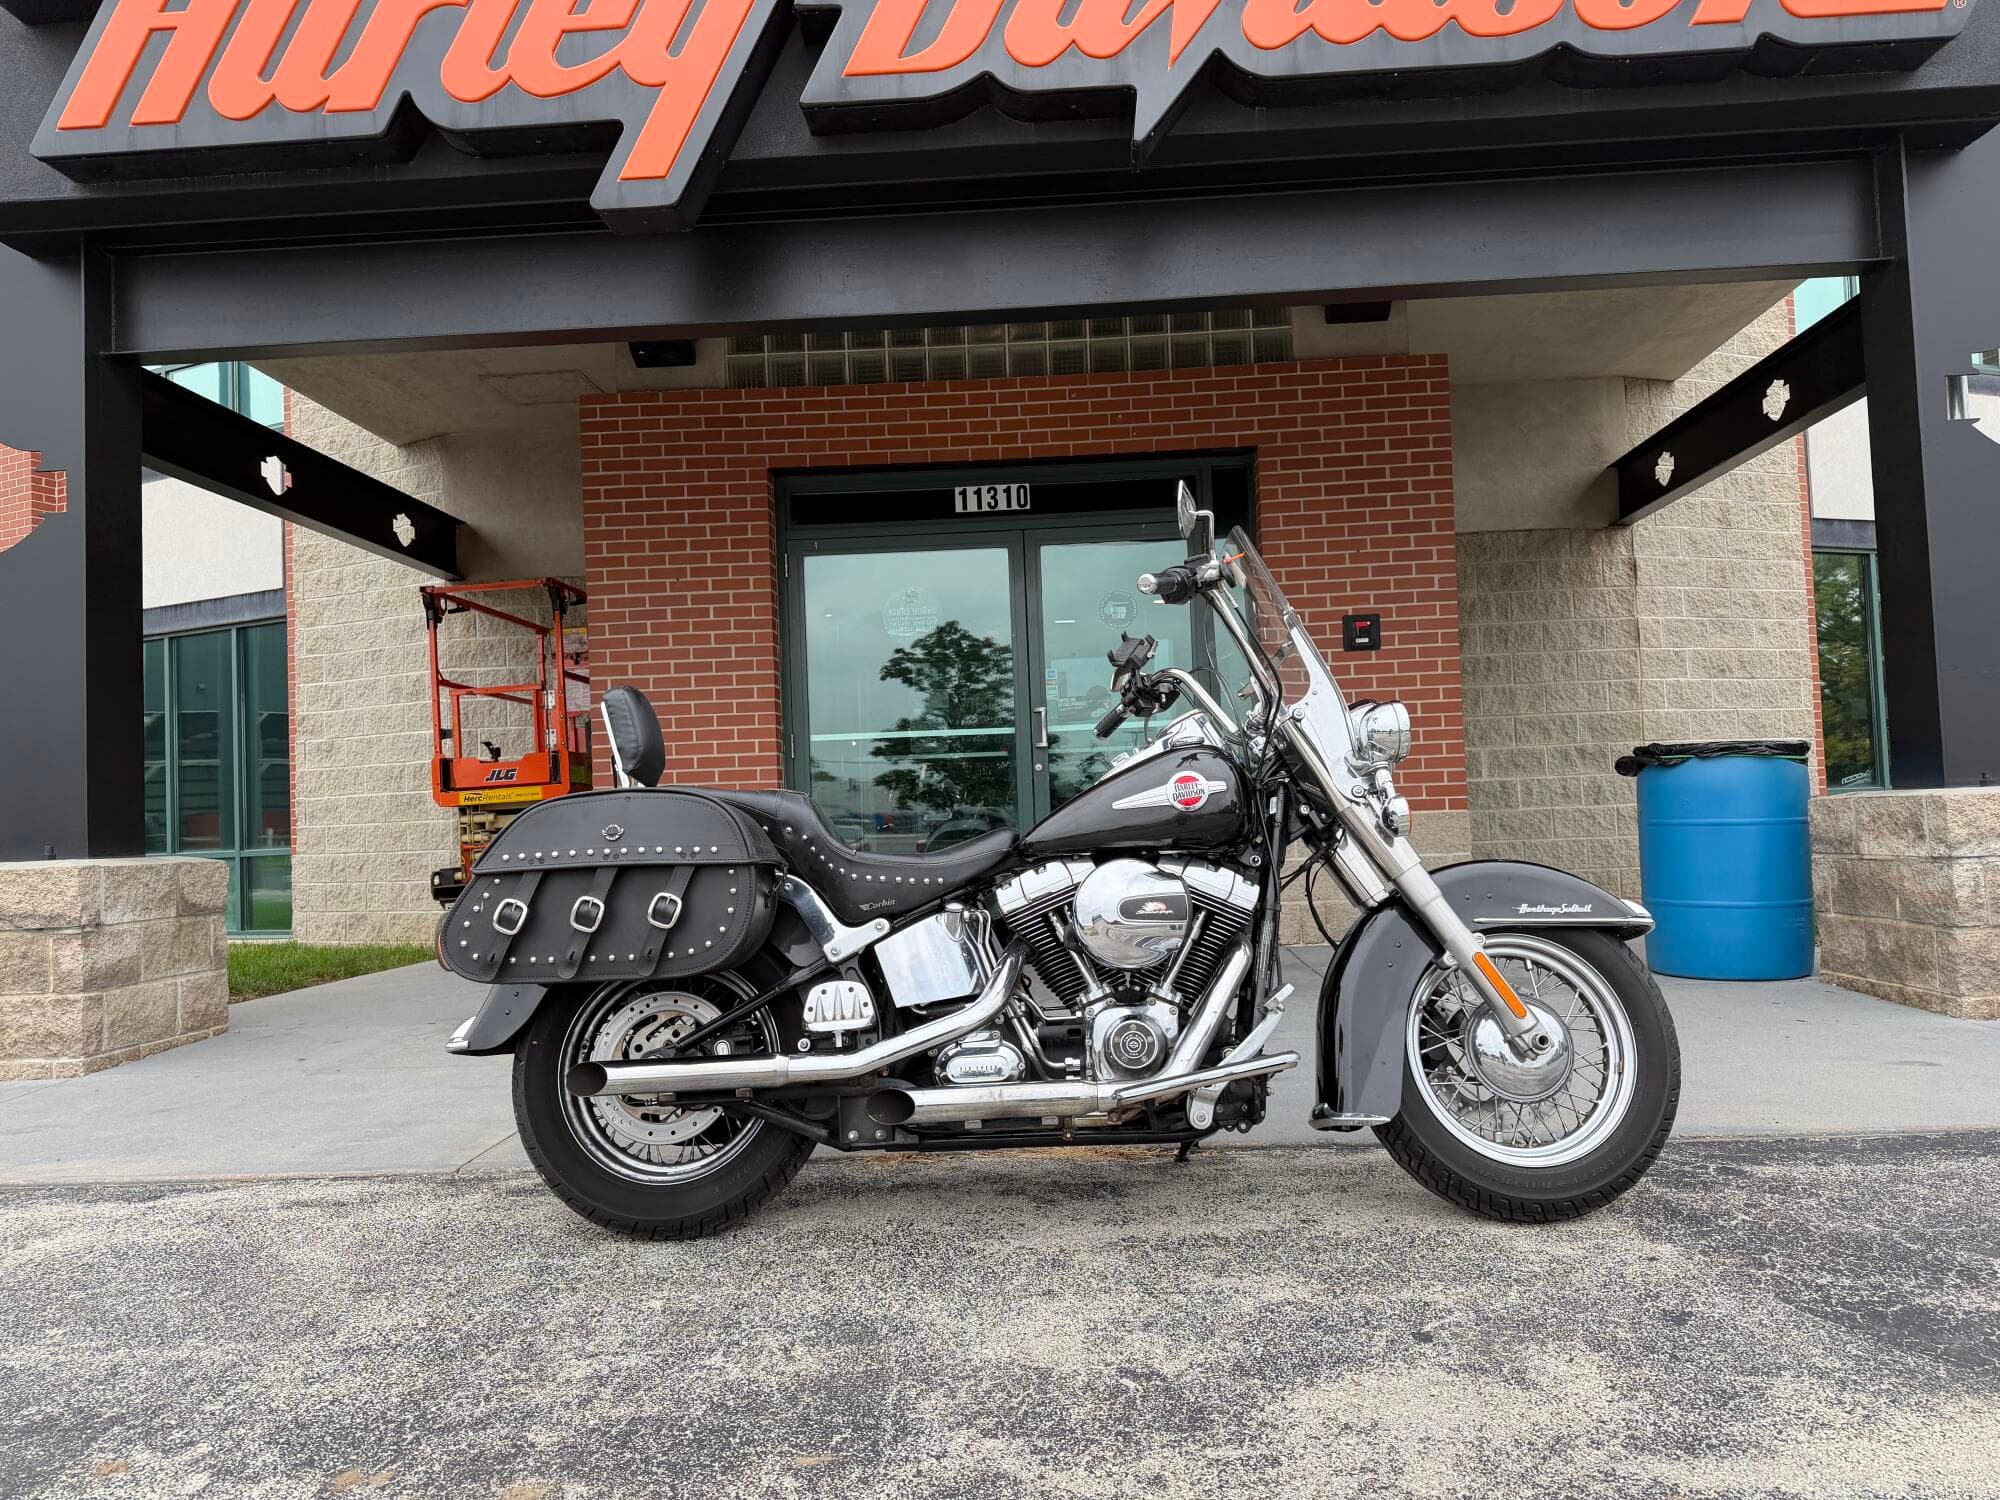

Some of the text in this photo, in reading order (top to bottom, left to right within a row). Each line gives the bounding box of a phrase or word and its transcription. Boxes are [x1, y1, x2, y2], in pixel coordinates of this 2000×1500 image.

[958, 484, 1029, 511] 11310
[485, 768, 518, 782] JLG
[1172, 788, 1205, 802] DAVIDSON
